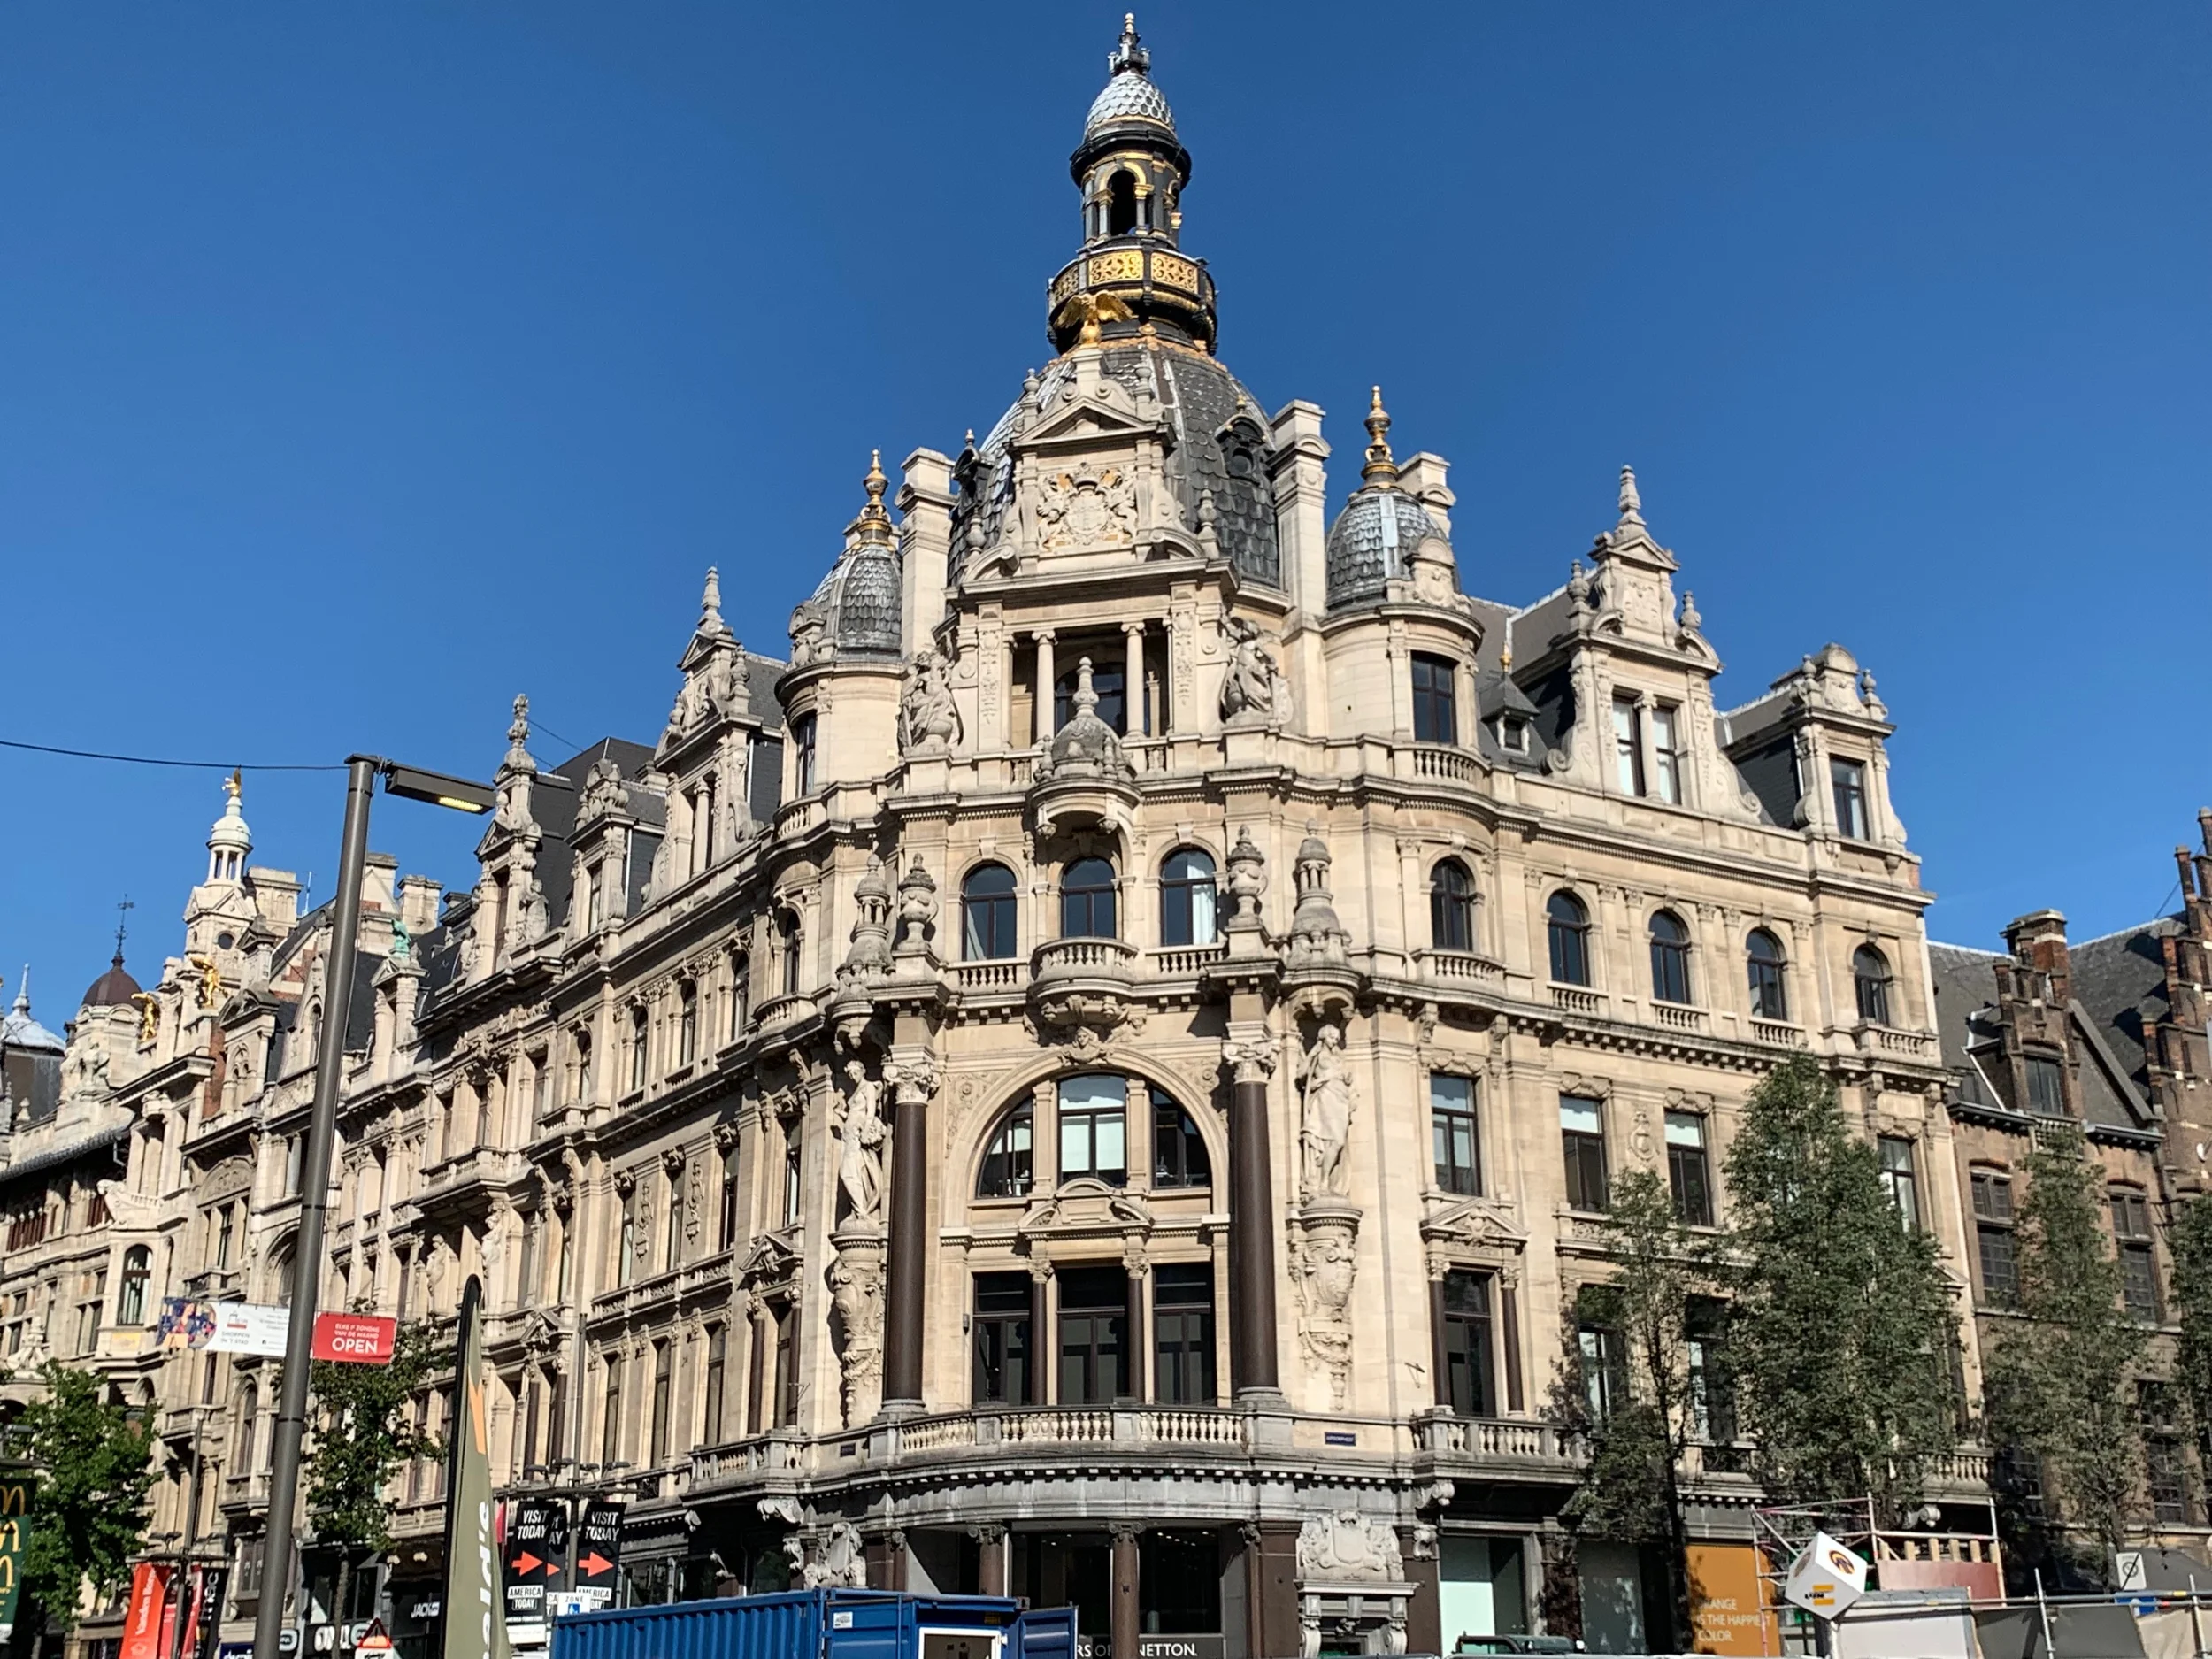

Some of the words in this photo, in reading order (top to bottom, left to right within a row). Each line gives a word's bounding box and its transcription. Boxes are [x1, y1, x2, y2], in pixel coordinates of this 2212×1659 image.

[332, 1337, 378, 1354] OPEN
[523, 1509, 549, 1524] VISIT
[591, 1512, 618, 1525] VISIT
[518, 1525, 548, 1540] TODAY
[585, 1526, 619, 1541] TODAY
[509, 1587, 541, 1596] AMERICA
[514, 1599, 535, 1609] TODAY
[1707, 1614, 1725, 1626] THE
